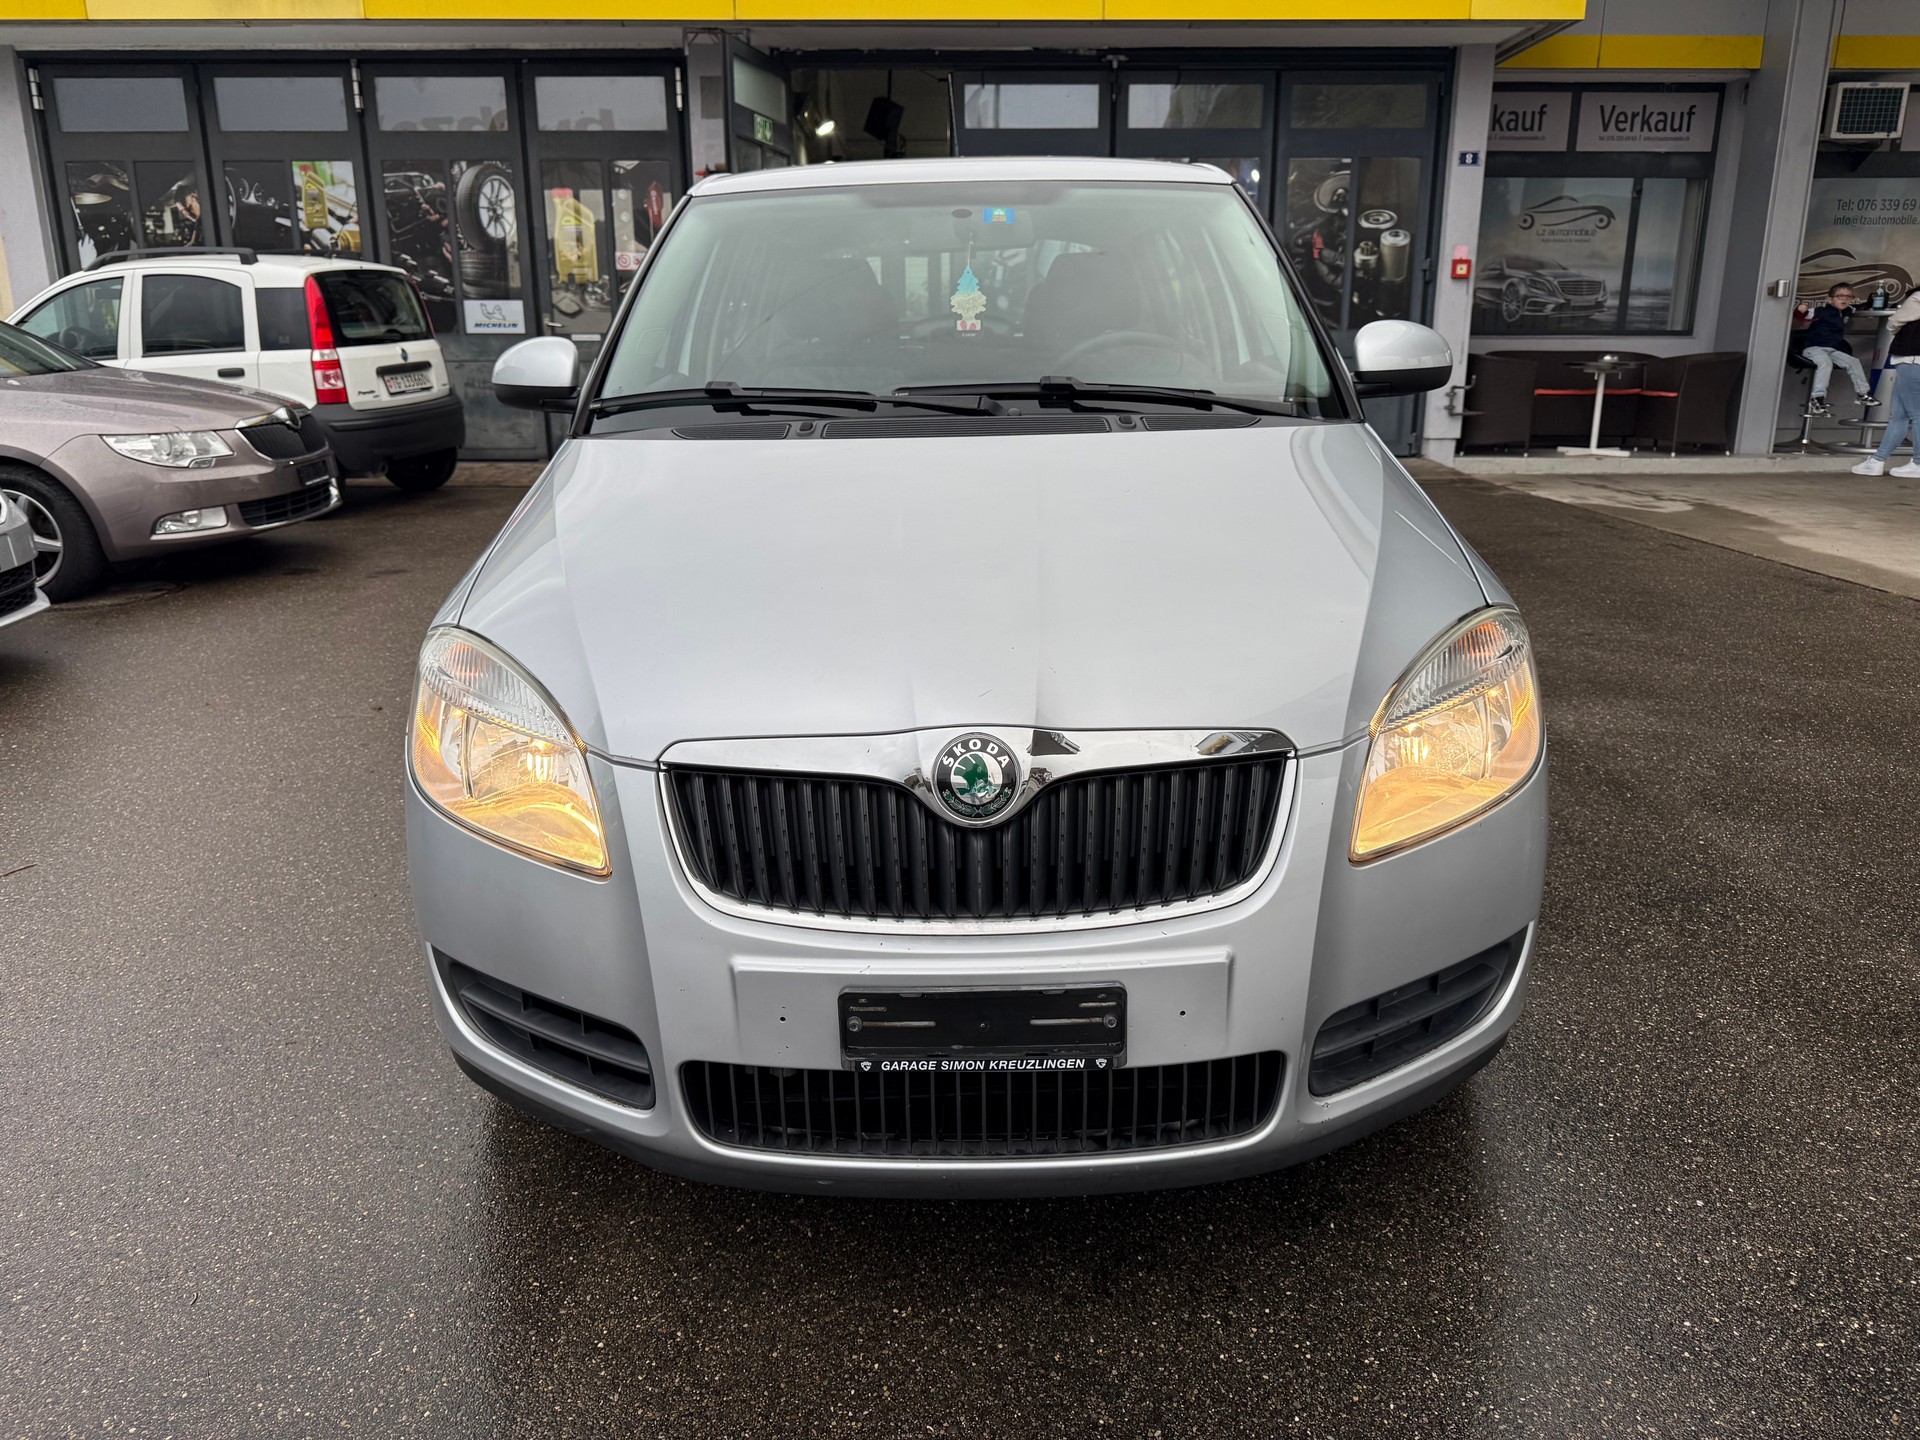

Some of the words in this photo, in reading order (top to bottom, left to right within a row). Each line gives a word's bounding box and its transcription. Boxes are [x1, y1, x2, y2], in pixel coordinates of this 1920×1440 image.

[1600, 104, 1697, 132] Verkauf
[1465, 152, 1473, 165] 8
[1837, 199, 1854, 211] Tel:
[1857, 199, 1877, 211] 076
[1880, 199, 1900, 211] 339
[1902, 199, 1917, 211] 69
[1834, 215, 1920, 226] info@lzautomobile.
[881, 1061, 936, 1071] GARAGE
[941, 1060, 984, 1070] SIMON
[989, 1059, 1085, 1070] KREUZLINGEN
